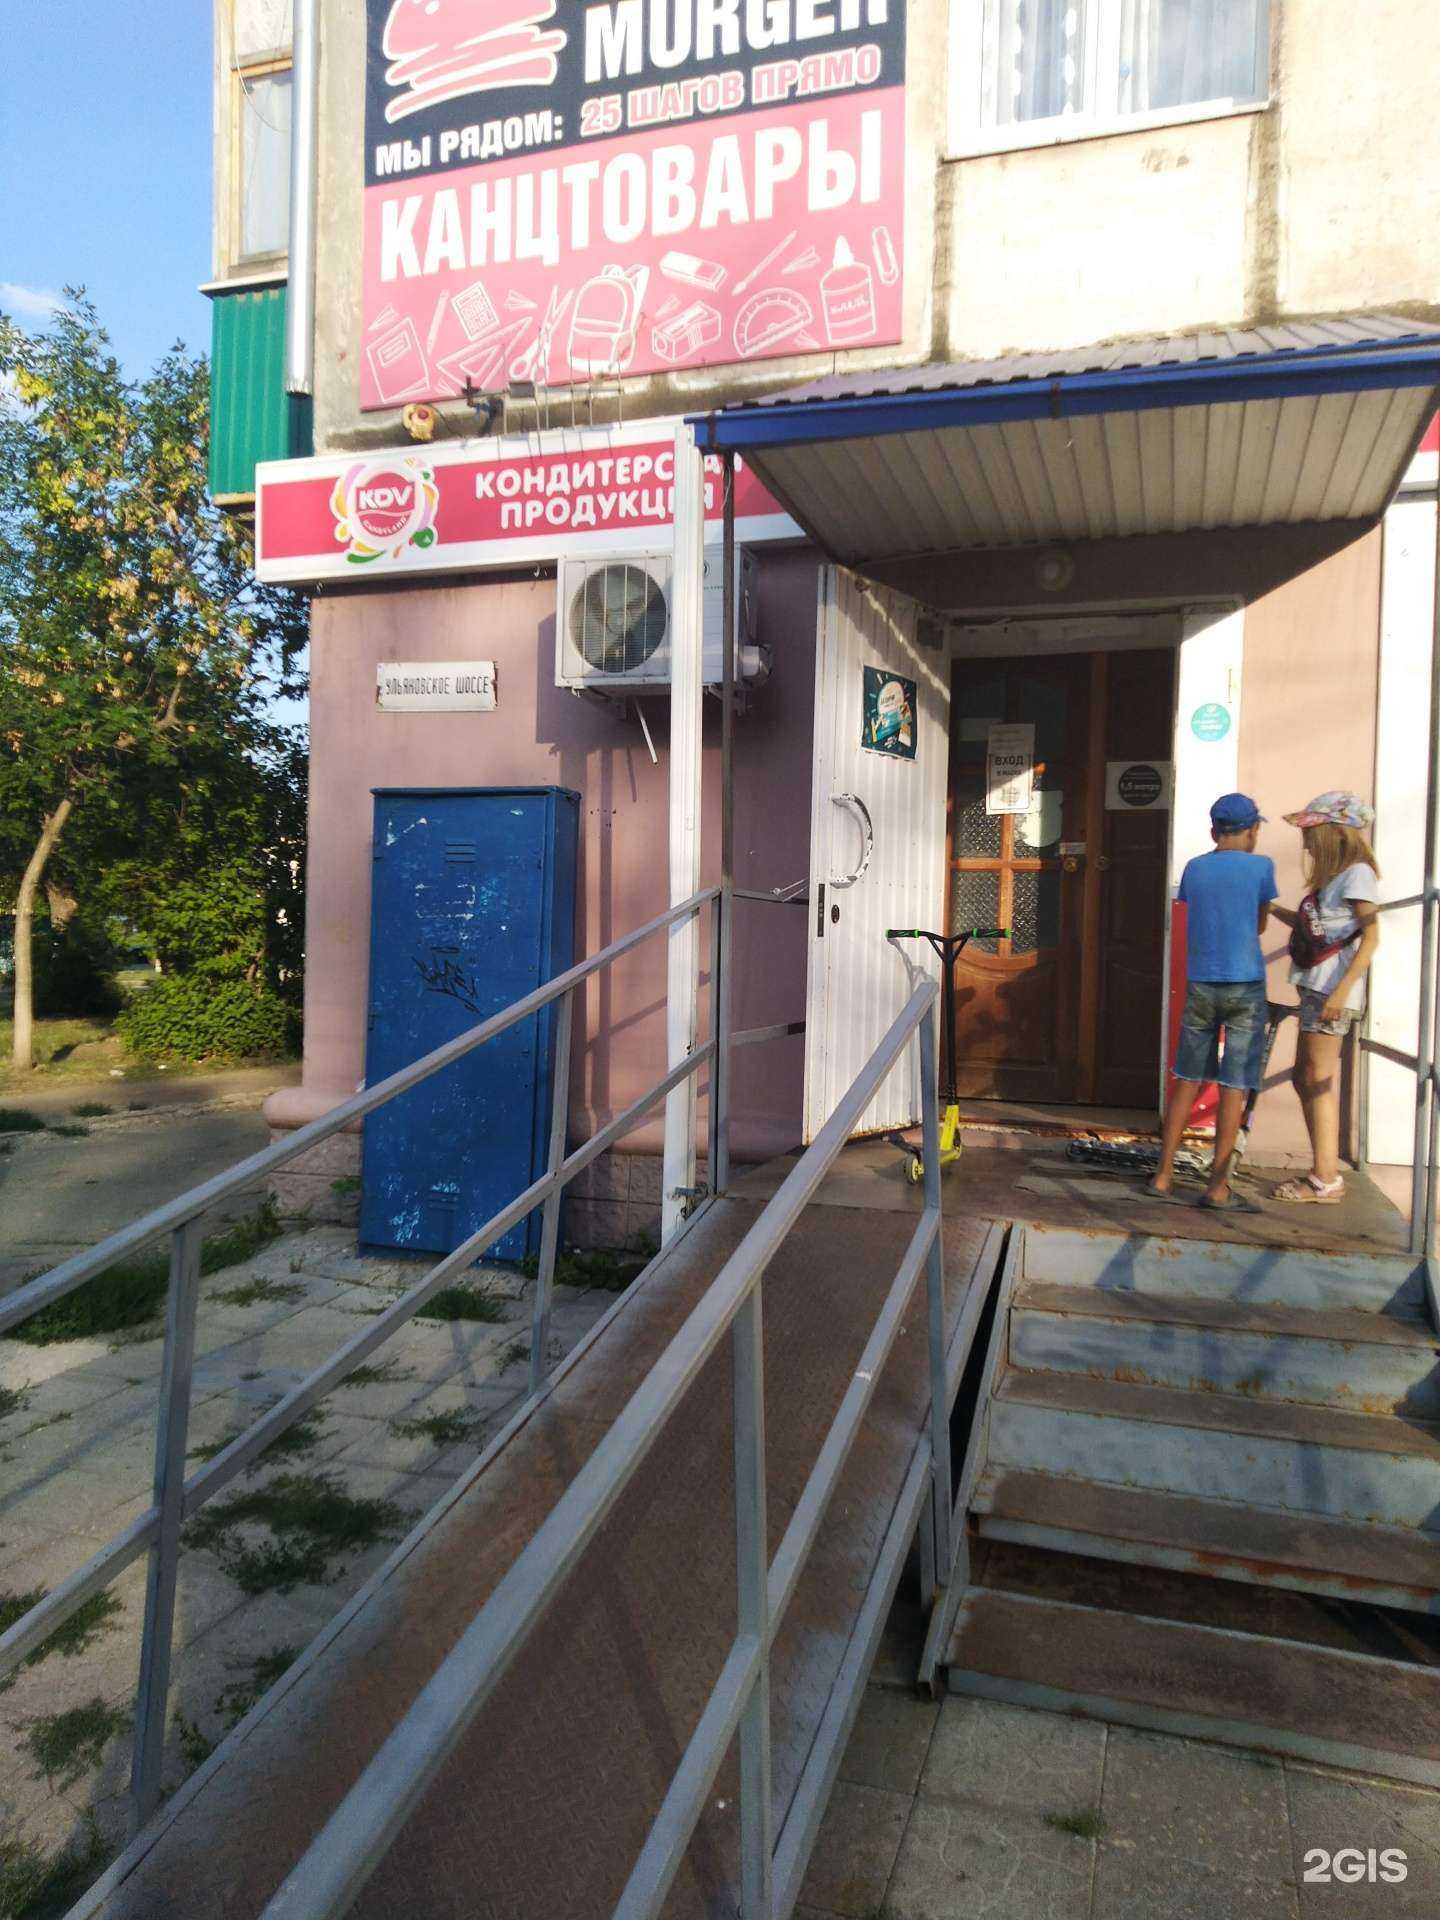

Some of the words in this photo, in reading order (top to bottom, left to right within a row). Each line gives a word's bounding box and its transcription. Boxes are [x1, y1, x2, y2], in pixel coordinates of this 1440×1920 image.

[375, 142, 431, 177] МЫ
[439, 112, 564, 164] РЯДОМ:
[580, 94, 622, 137] 25
[627, 70, 745, 127] ШАГОВ
[751, 43, 881, 104] ПРЯМО
[380, 109, 883, 282] КАНЦТОВАРЫ
[358, 485, 413, 509] KDV
[456, 676, 489, 694] ШОССЕ
[995, 755, 1024, 766] ВХОД
